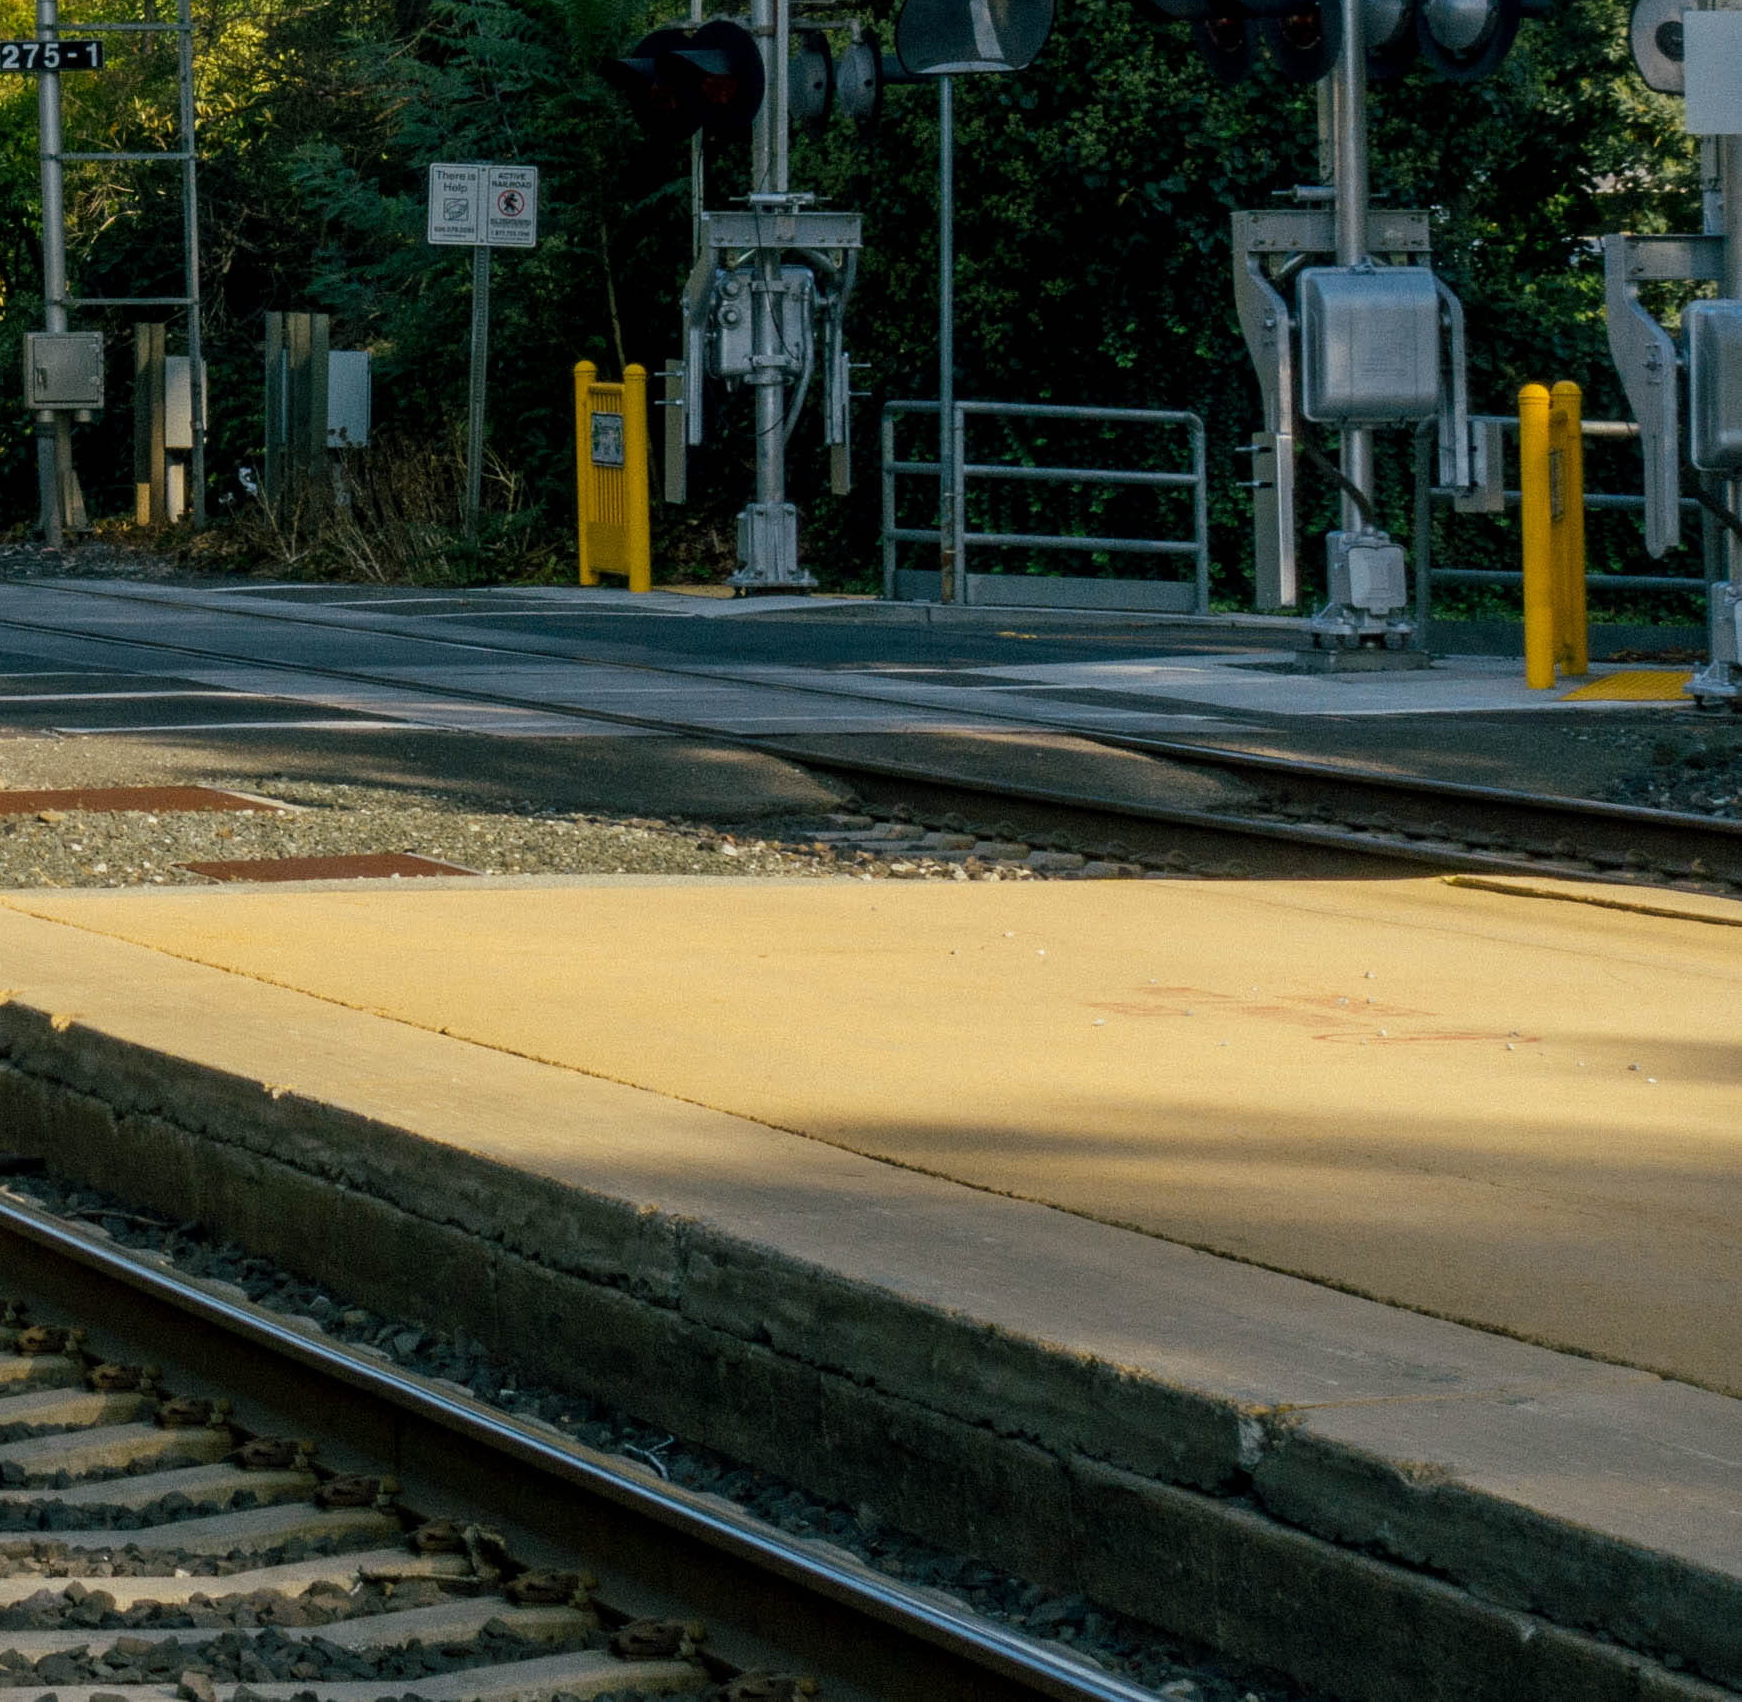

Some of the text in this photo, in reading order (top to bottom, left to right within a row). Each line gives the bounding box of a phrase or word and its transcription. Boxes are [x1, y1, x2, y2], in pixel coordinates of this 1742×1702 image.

[1, 42, 98, 69] 275-1
[435, 169, 466, 181] There
[443, 182, 468, 194] Help
